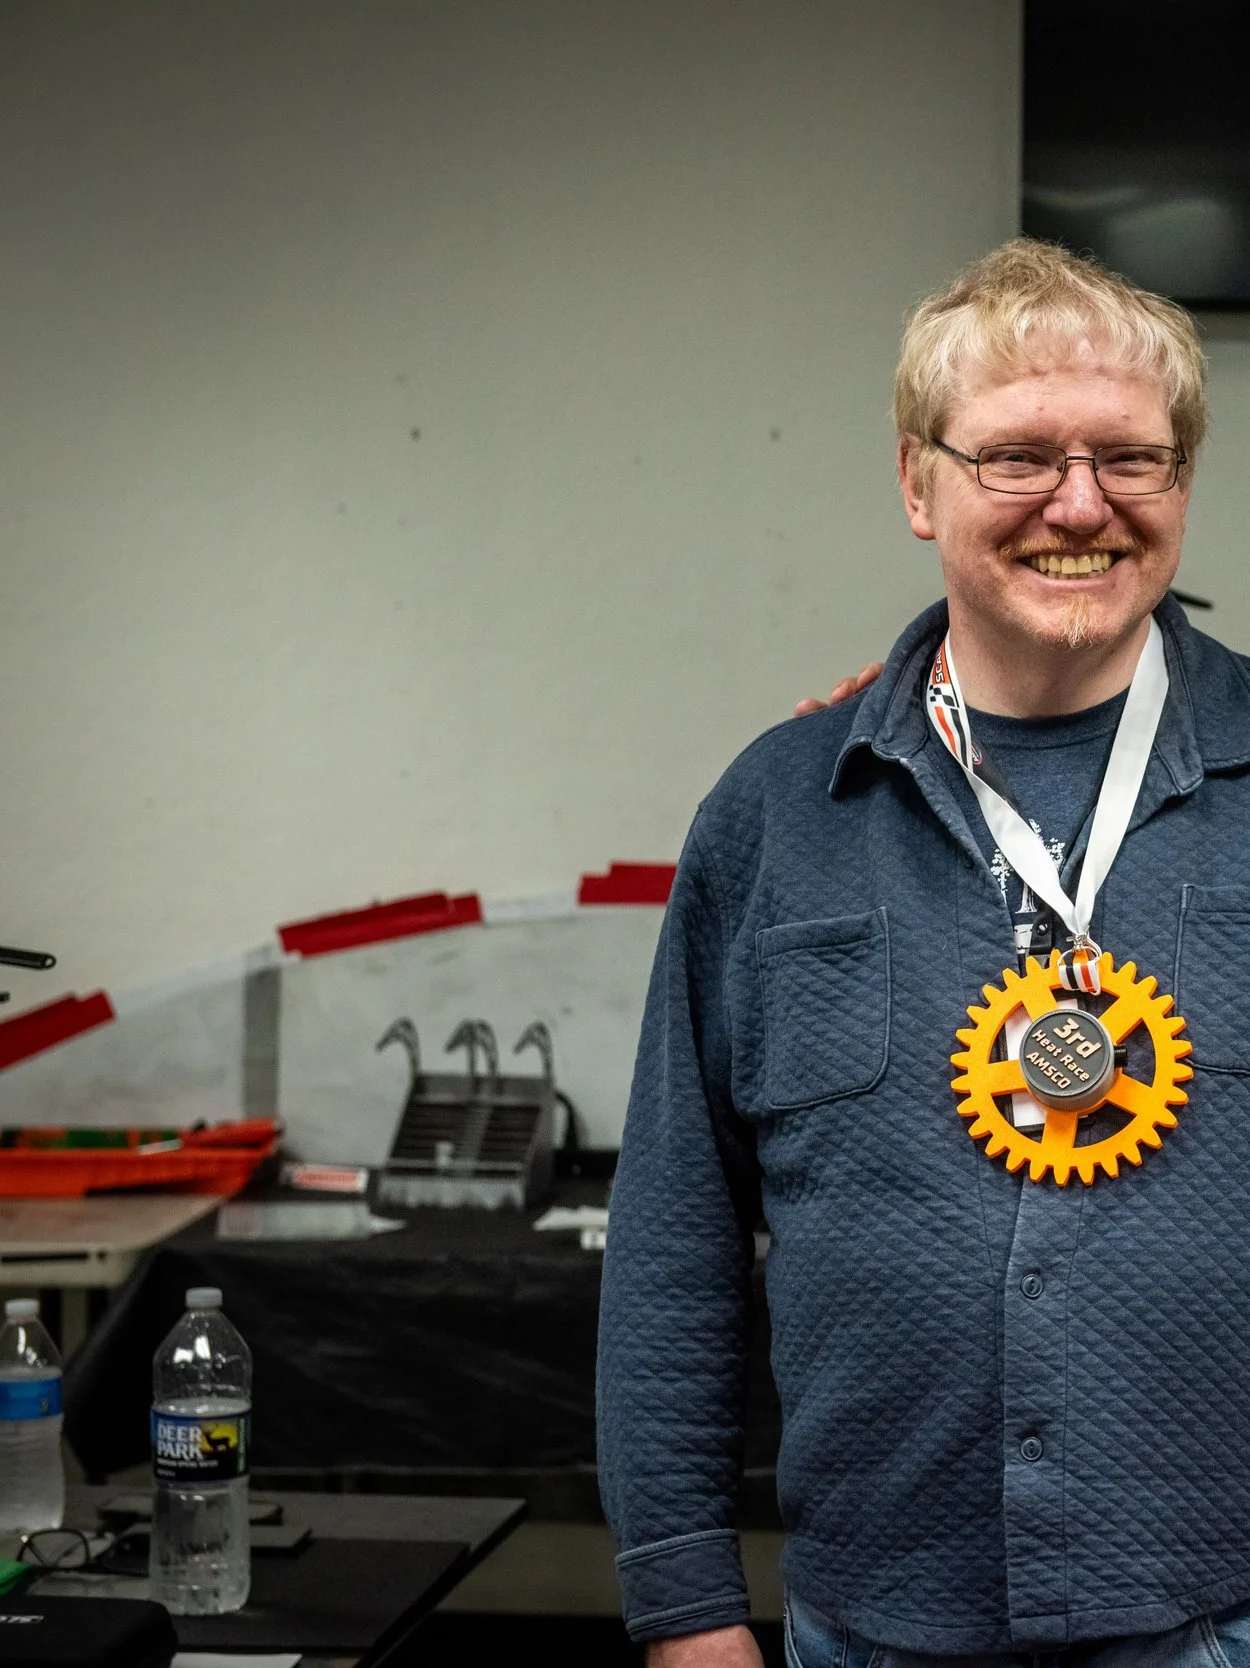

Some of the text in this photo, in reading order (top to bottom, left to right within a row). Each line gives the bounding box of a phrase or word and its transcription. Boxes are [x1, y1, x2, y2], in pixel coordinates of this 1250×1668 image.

[1032, 1029, 1090, 1082] Heat Race
[1053, 1017, 1102, 1059] 3rd
[1026, 1051, 1072, 1089] AMSCO
[157, 1422, 203, 1443] DEER
[157, 1440, 205, 1461] PARK
